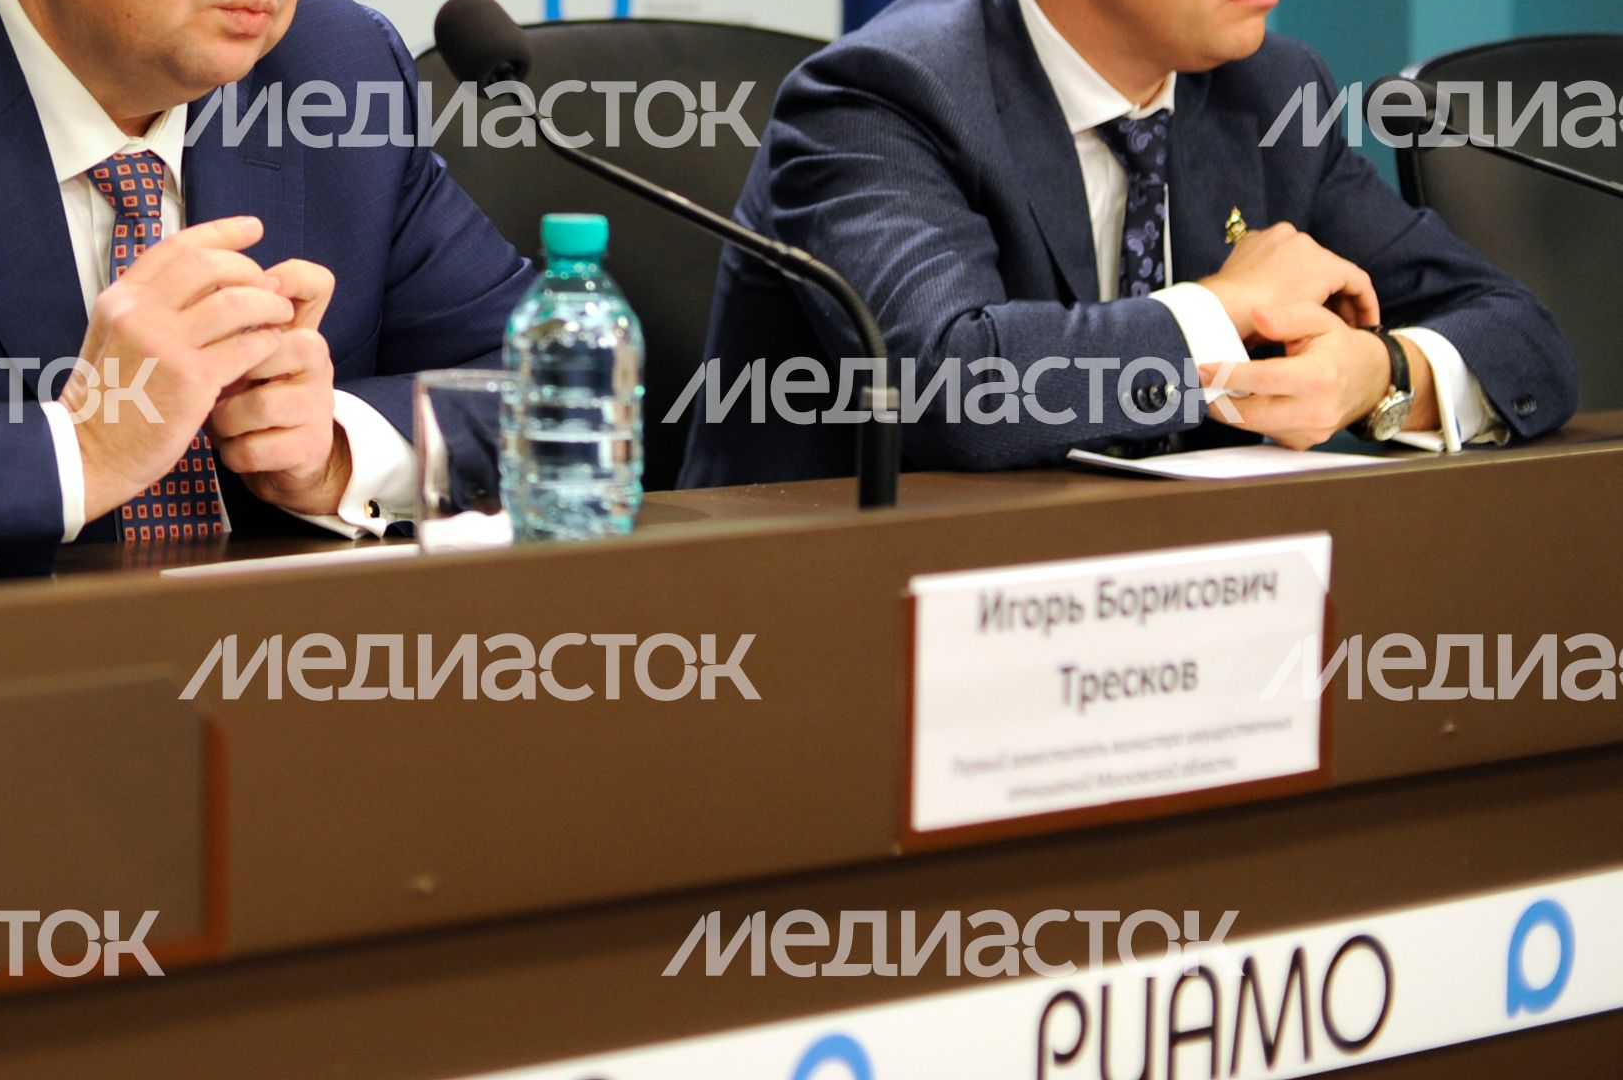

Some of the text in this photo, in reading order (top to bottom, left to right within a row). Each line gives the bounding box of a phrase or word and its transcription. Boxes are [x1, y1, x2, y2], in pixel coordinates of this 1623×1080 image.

[977, 569, 1280, 636] Игорь Борисович
[1058, 659, 1200, 713] Тресков
[1035, 933, 1396, 1080] РИАМО
